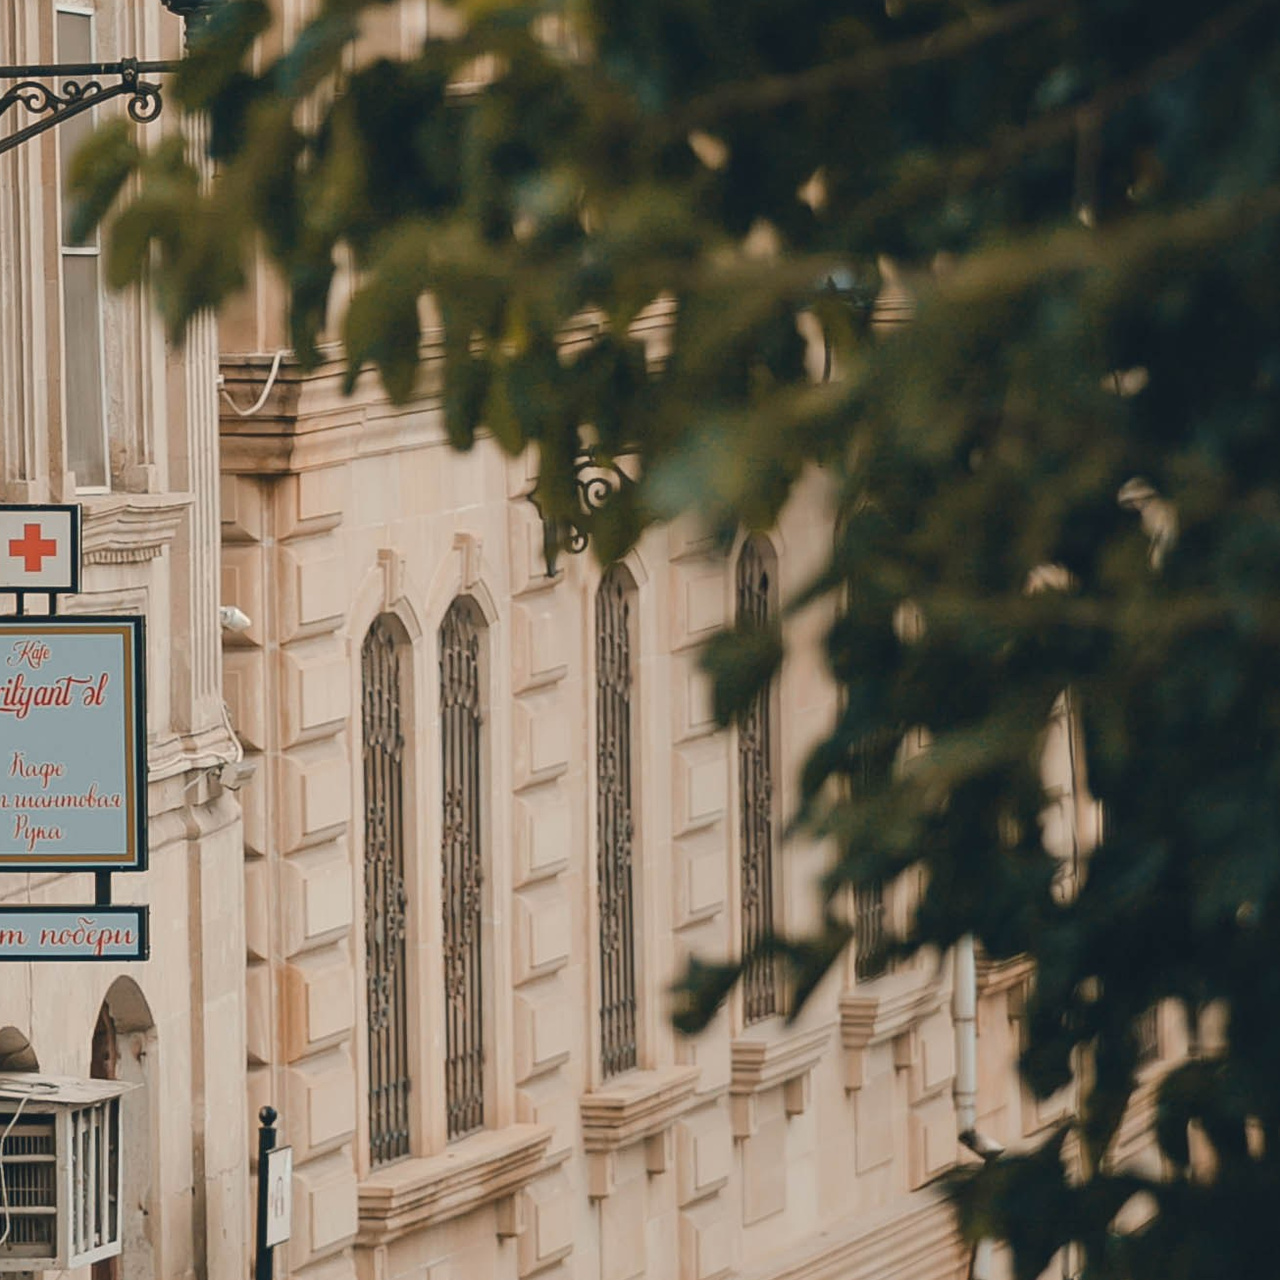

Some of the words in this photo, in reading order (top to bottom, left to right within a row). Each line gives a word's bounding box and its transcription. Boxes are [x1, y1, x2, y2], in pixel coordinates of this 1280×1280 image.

[7, 640, 51, 668] Kafe
[10, 751, 64, 788] Кафе
[13, 814, 63, 851] Рука
[40, 917, 137, 957] побери
